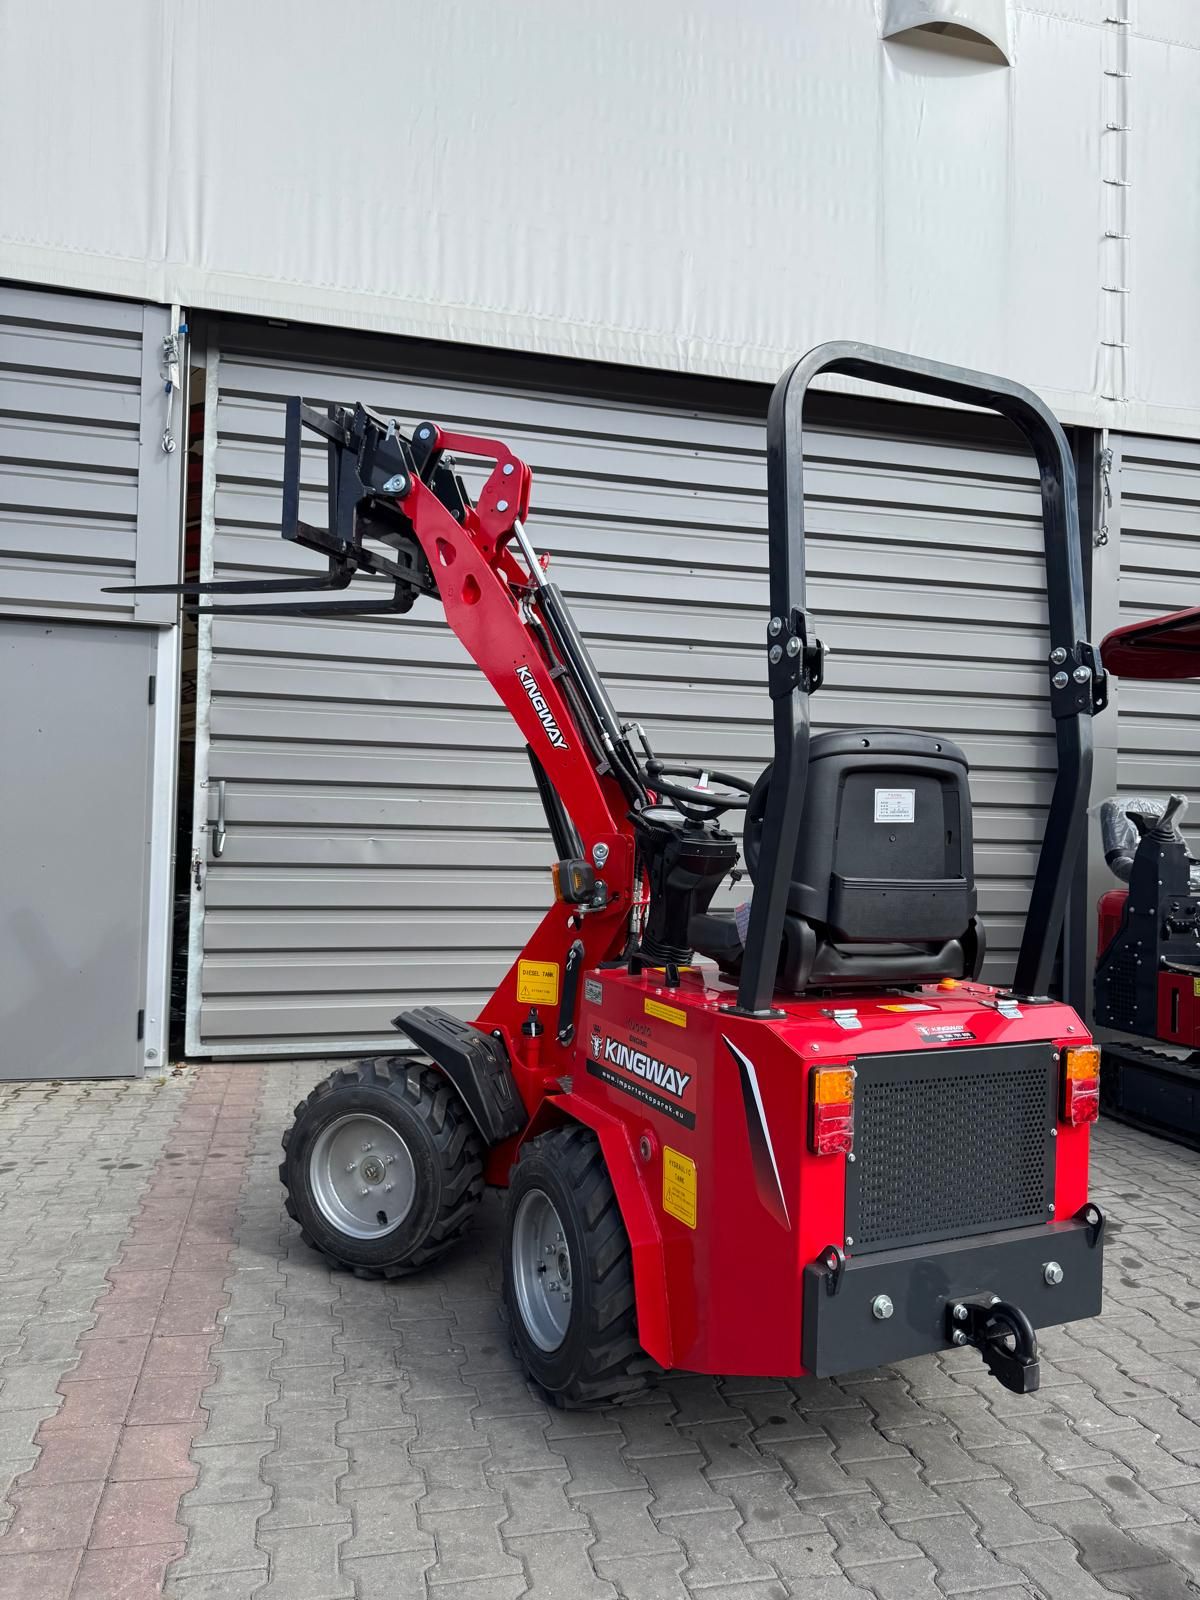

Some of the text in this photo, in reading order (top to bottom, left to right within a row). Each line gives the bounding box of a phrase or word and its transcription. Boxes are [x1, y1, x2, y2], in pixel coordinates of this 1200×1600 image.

[515, 665, 569, 750] KINGWAY
[522, 969, 540, 977] DIESEL
[603, 1036, 691, 1098] KINGWAY
[602, 1071, 684, 1119] www.importerkoparek.eu
